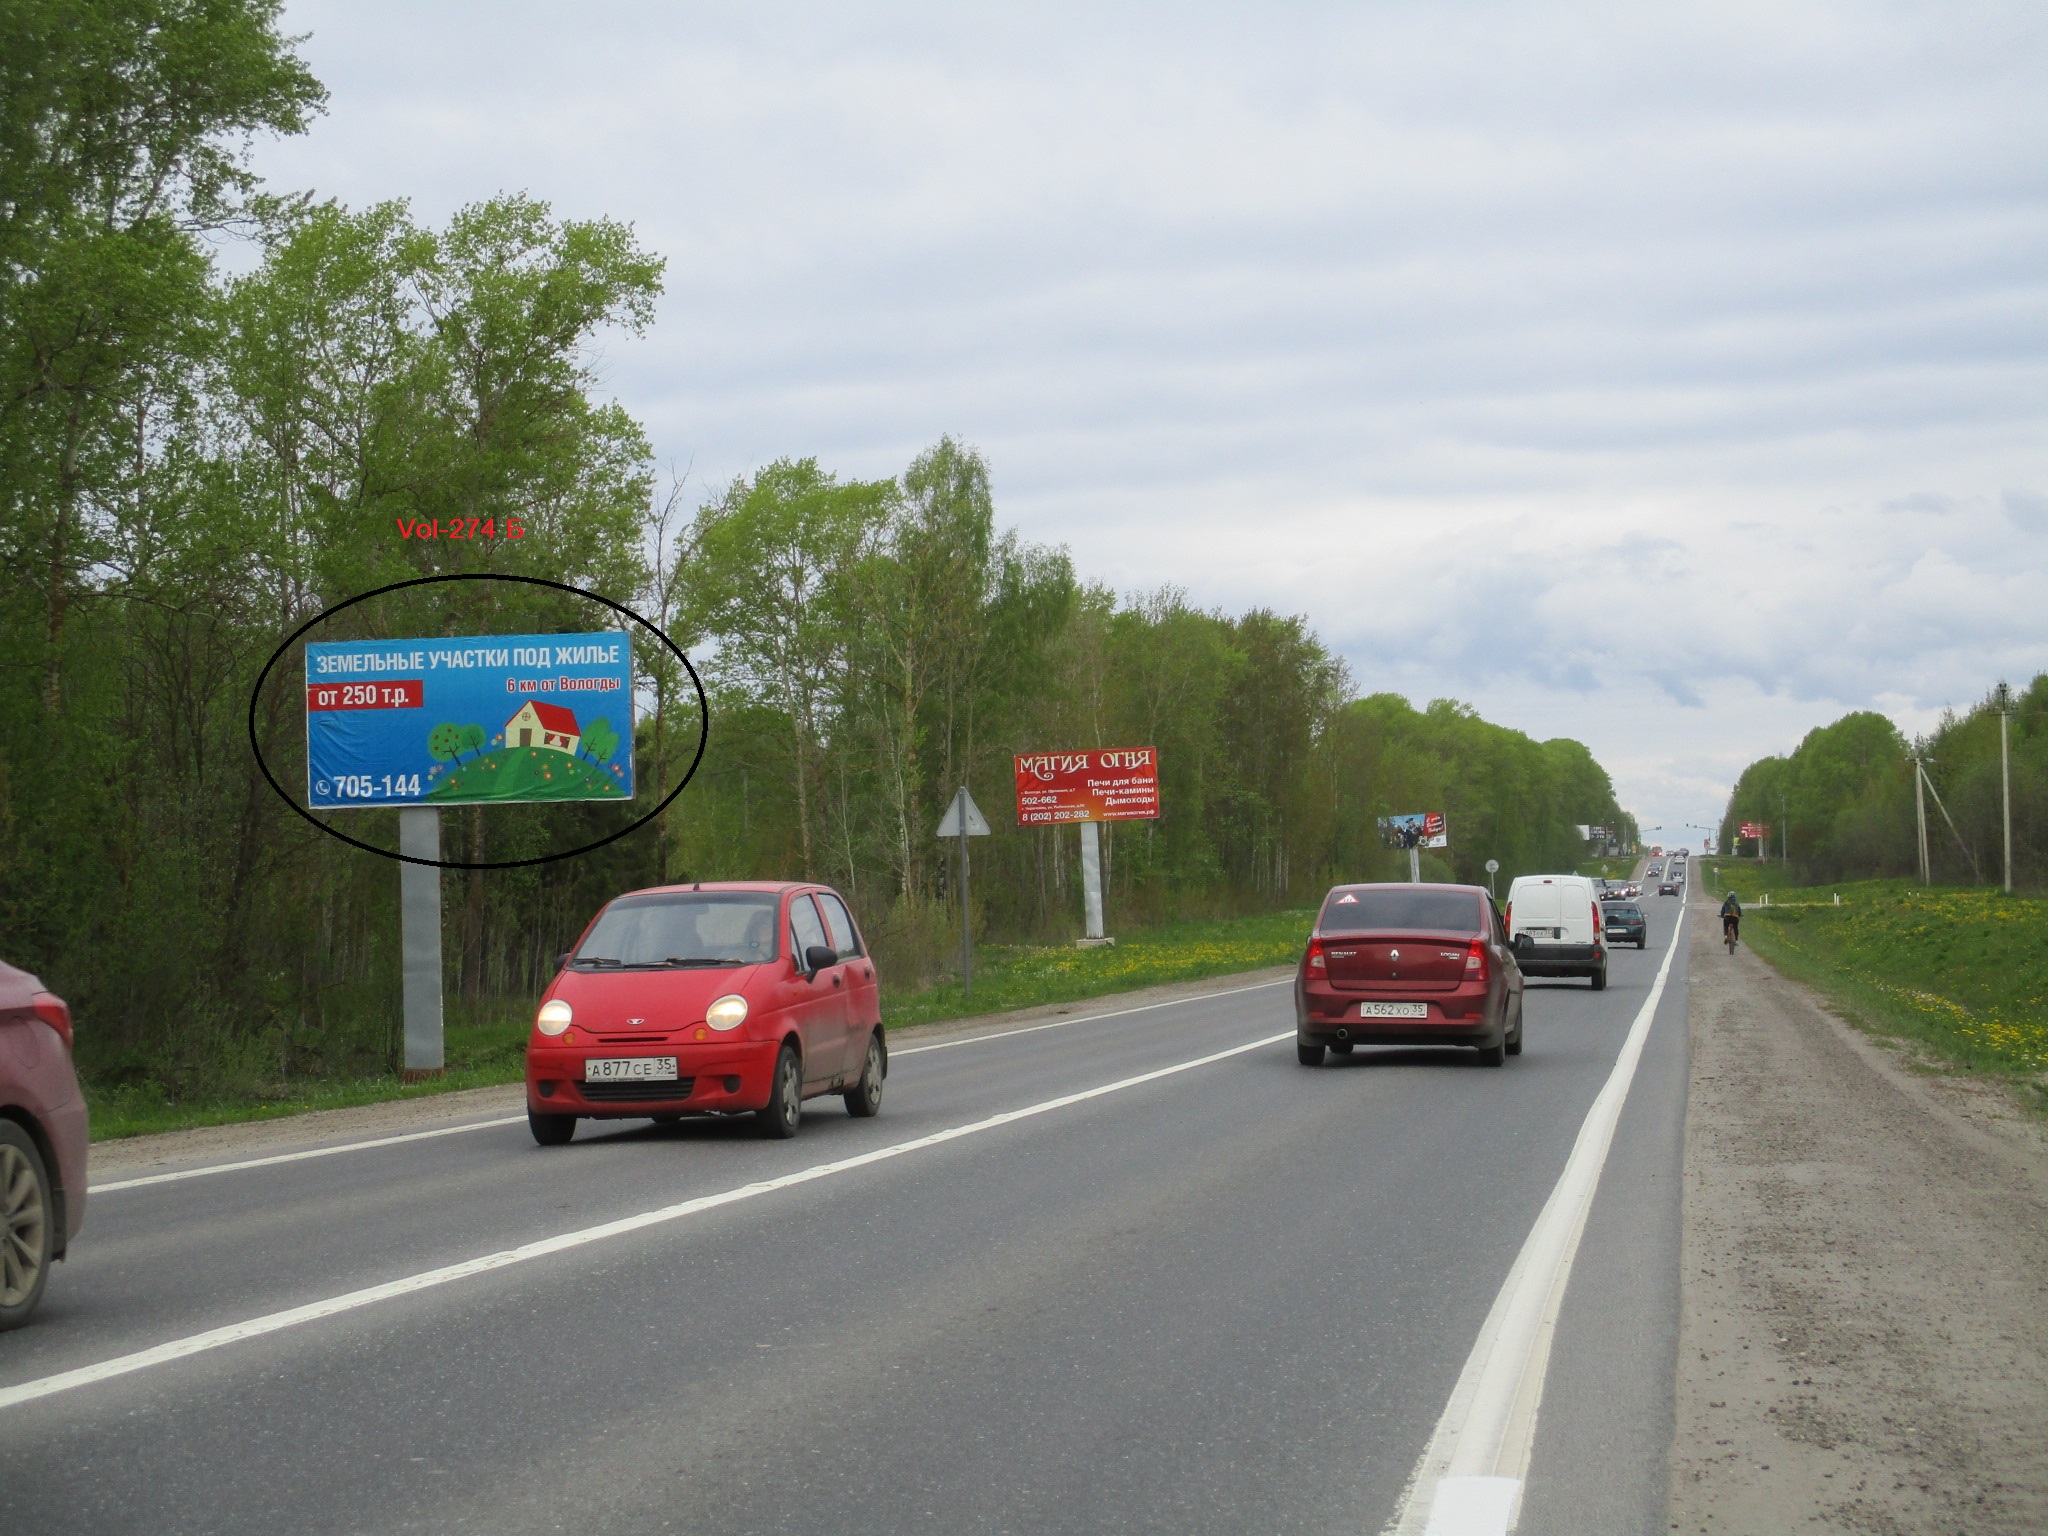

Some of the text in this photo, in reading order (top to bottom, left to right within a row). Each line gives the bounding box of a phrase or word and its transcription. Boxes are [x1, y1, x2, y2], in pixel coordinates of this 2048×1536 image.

[316, 645, 620, 674] ЗЕМЕЛЬНЫЕ УЧАСТКИ ПОД ЖИЛЬЕ
[507, 675, 621, 693] 6 км от Вологды
[318, 684, 409, 707] от 250 т.р.
[1019, 750, 1152, 781] МАГИЯ ОГНЯ
[333, 774, 421, 798] 705-144
[1087, 776, 1154, 787] Печи для бани
[1092, 786, 1155, 796] Печи-камины
[1021, 796, 1058, 805] 502-662
[1105, 796, 1155, 806] Дымоходы
[1022, 810, 1090, 822] 8 (202) 202-282
[656, 1058, 672, 1070] 35
